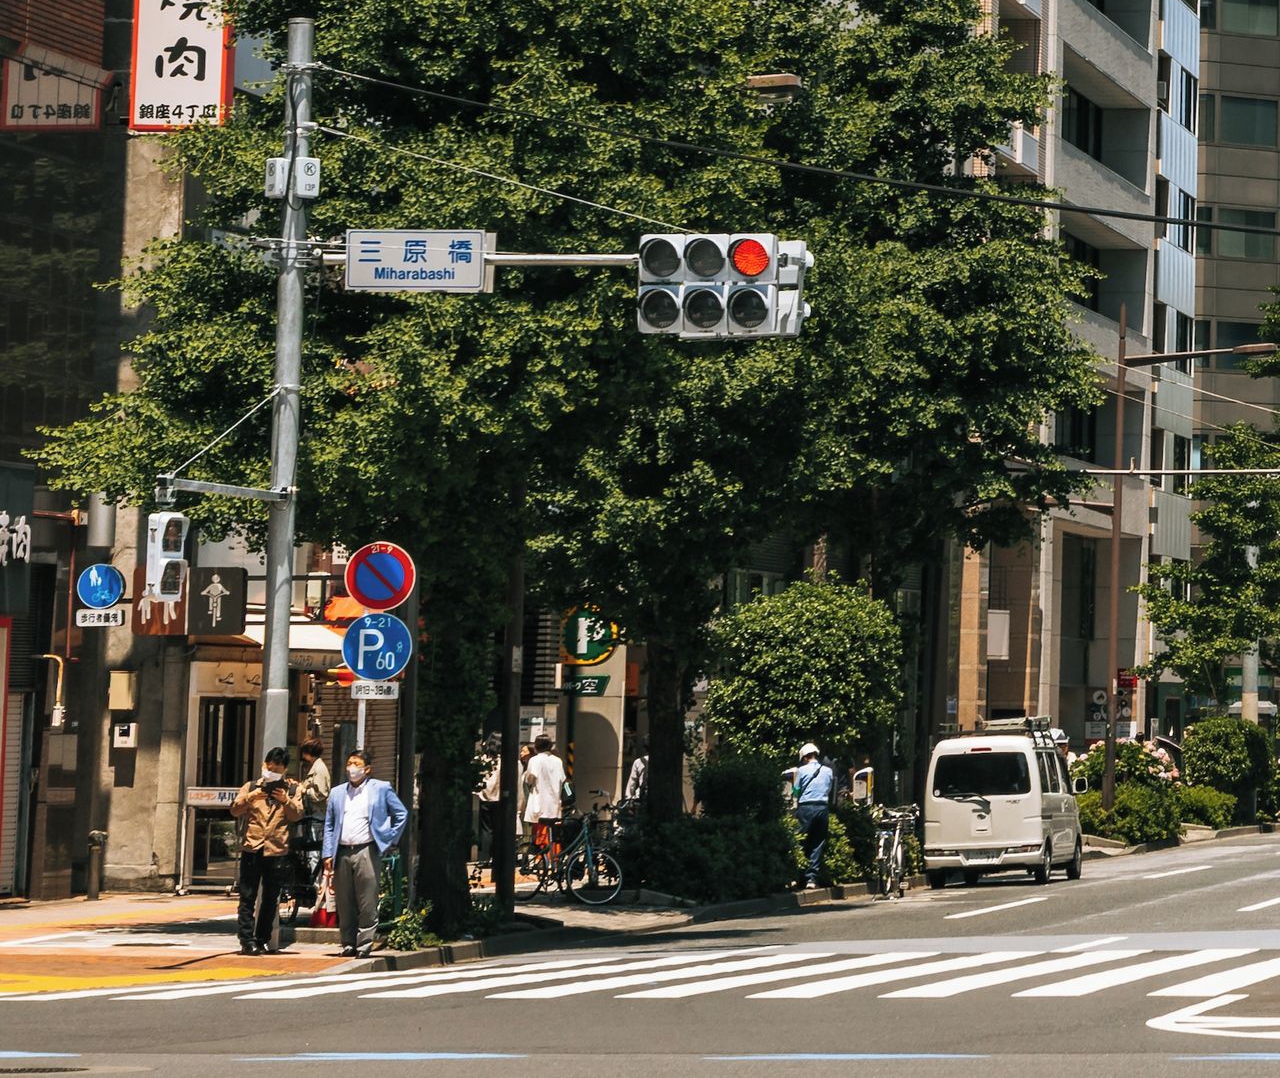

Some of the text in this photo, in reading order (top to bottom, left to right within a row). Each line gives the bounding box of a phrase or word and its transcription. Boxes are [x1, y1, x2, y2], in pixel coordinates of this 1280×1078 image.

[358, 240, 473, 264] 三原橋
[374, 267, 455, 280] Miharabashi
[371, 546, 393, 554] 21-9
[80, 613, 119, 623] 歩行者優先
[364, 618, 392, 628] 9-21
[357, 628, 385, 670] P
[375, 651, 396, 670] 60
[581, 678, 599, 693] 空
